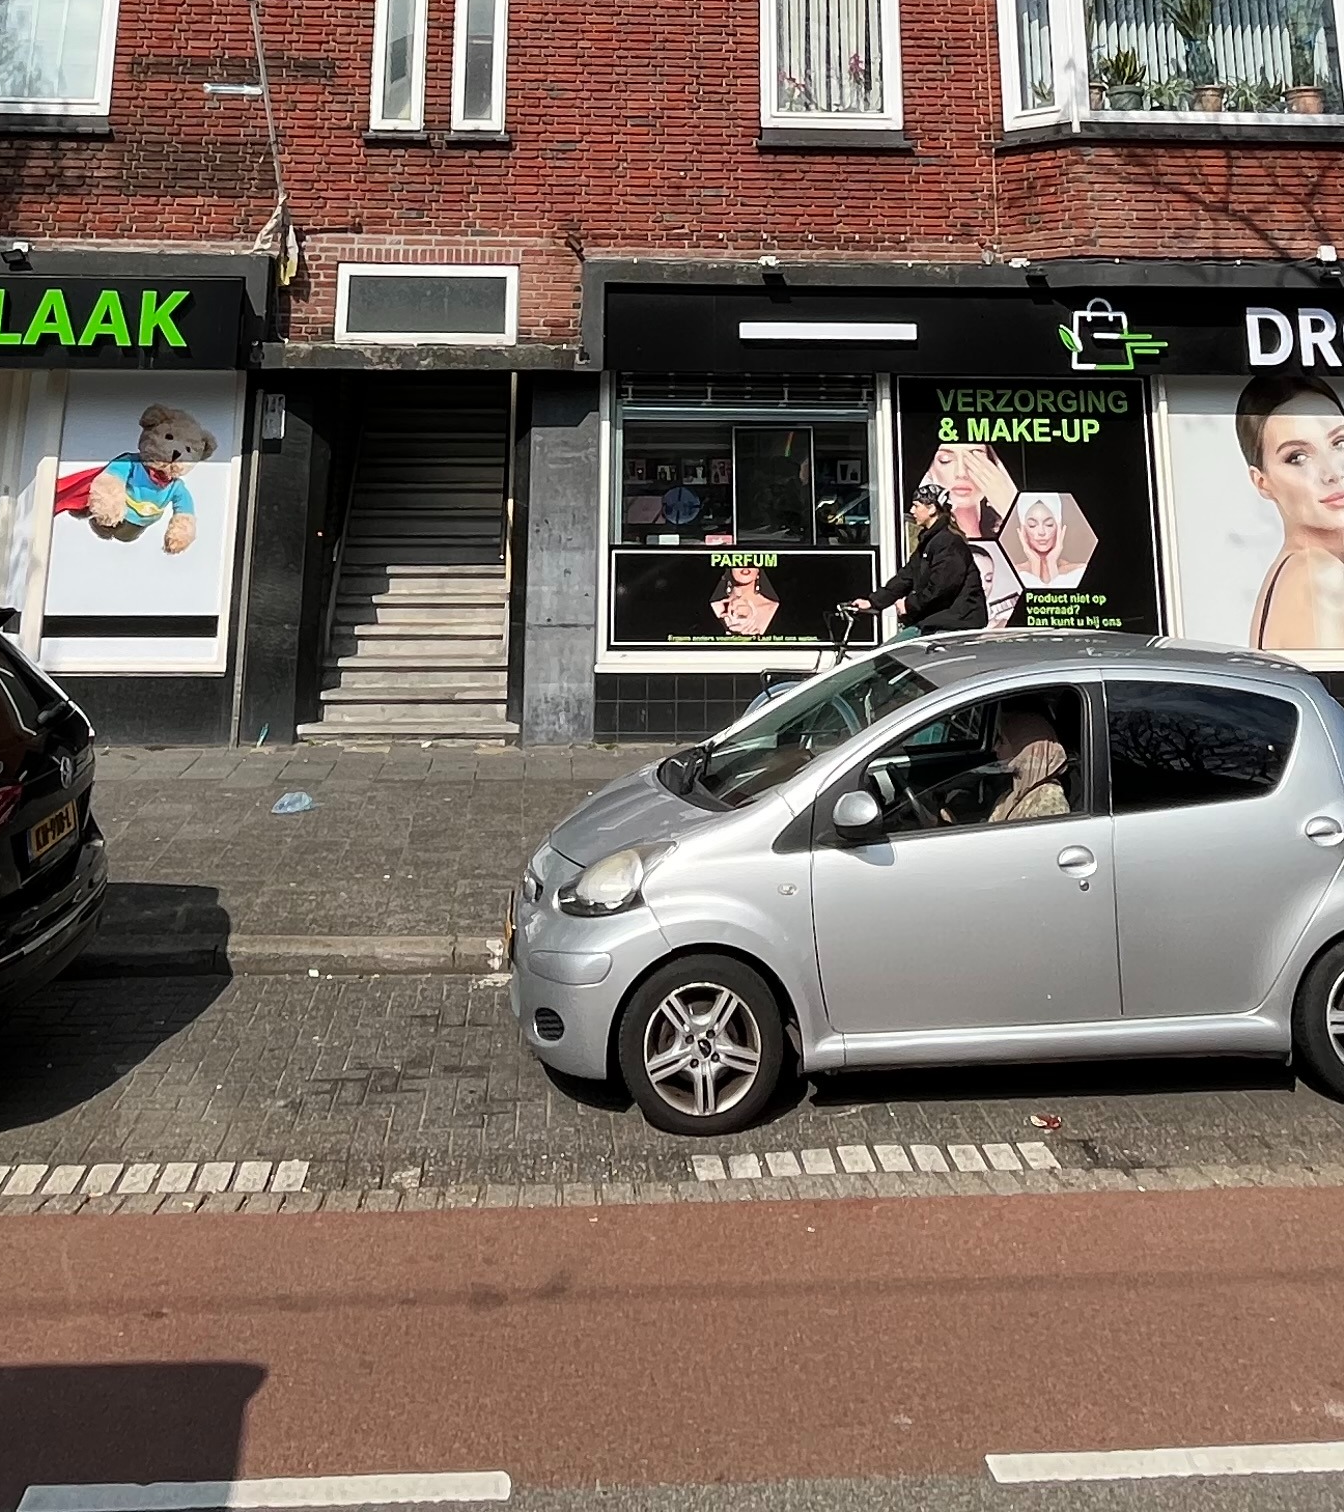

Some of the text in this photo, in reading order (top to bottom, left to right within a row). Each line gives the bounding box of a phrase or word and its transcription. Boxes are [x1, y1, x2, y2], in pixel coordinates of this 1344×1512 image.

[936, 389, 1128, 414] VERZORGING
[938, 417, 1100, 443] & MAKE-UP
[711, 554, 777, 567] PARFUM
[1026, 593, 1106, 605] Product niet op
[1026, 605, 1080, 615] voorraad?
[1027, 616, 1048, 626] Dan
[1051, 616, 1075, 626] kunt
[1102, 619, 1122, 627] ons
